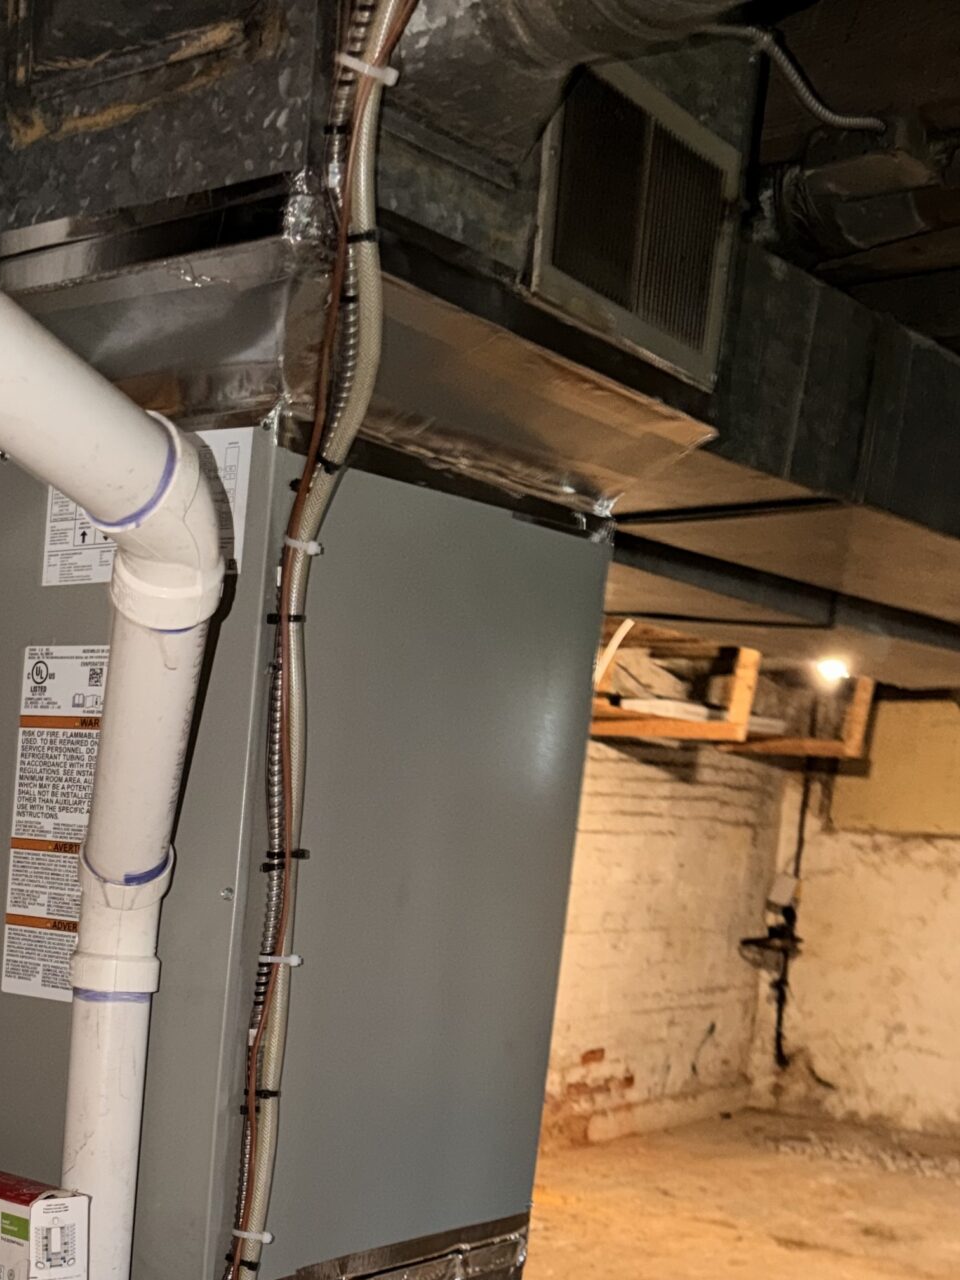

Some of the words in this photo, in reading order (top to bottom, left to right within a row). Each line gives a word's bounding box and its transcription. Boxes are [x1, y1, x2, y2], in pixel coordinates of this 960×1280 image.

[80, 718, 100, 728] WAR
[22, 730, 35, 738] RISK
[37, 730, 45, 738] OF
[62, 731, 100, 739] FLAMMABLE
[58, 739, 89, 747] REPAIRED
[85, 747, 96, 755] DO
[20, 752, 61, 760] REFRIGERANT
[19, 759, 26, 767] IN
[26, 760, 68, 769] ACCORDANCE
[60, 792, 93, 800] INSTALLED
[55, 798, 86, 806] AUXILIARY
[58, 806, 85, 814] SPECIFIC
[53, 843, 80, 854] AVERTI
[52, 920, 78, 930] ADVER
